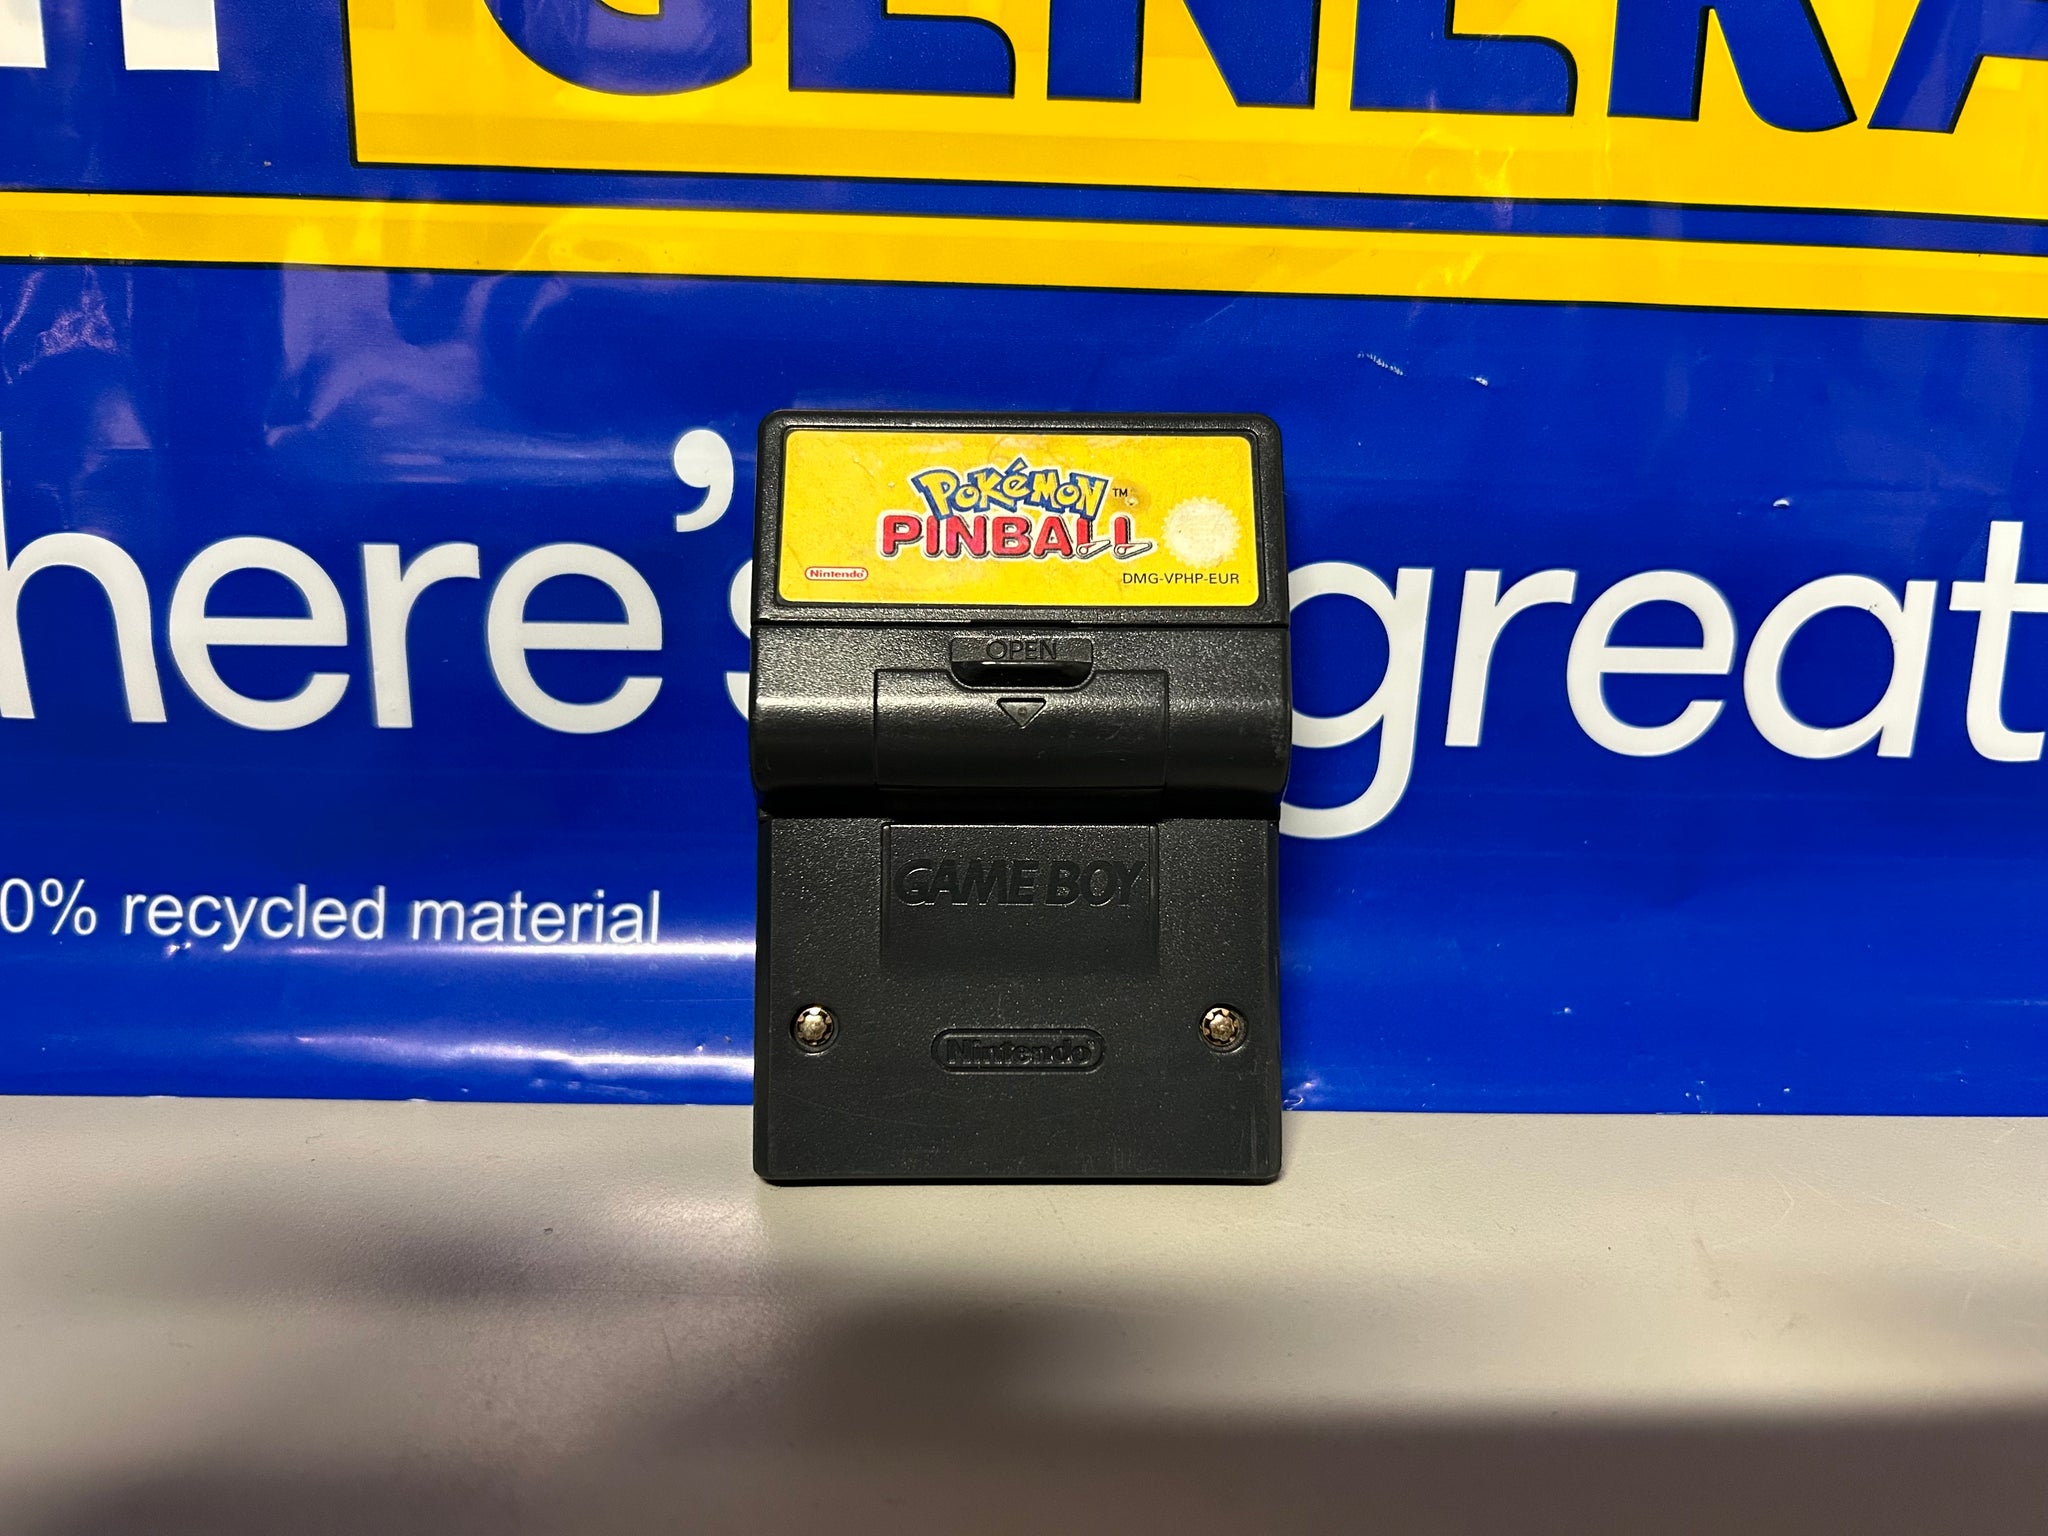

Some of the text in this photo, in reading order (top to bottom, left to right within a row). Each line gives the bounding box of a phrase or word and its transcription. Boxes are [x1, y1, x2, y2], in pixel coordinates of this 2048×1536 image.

[883, 515, 1153, 559] PINBALL
[1122, 573, 1240, 585] DMG-VPHP-EUR
[986, 640, 1057, 660] OPEN
[1279, 520, 2048, 840] great
[894, 859, 1147, 907] GAME BOY
[123, 883, 387, 952] recycled
[412, 889, 662, 944] material
